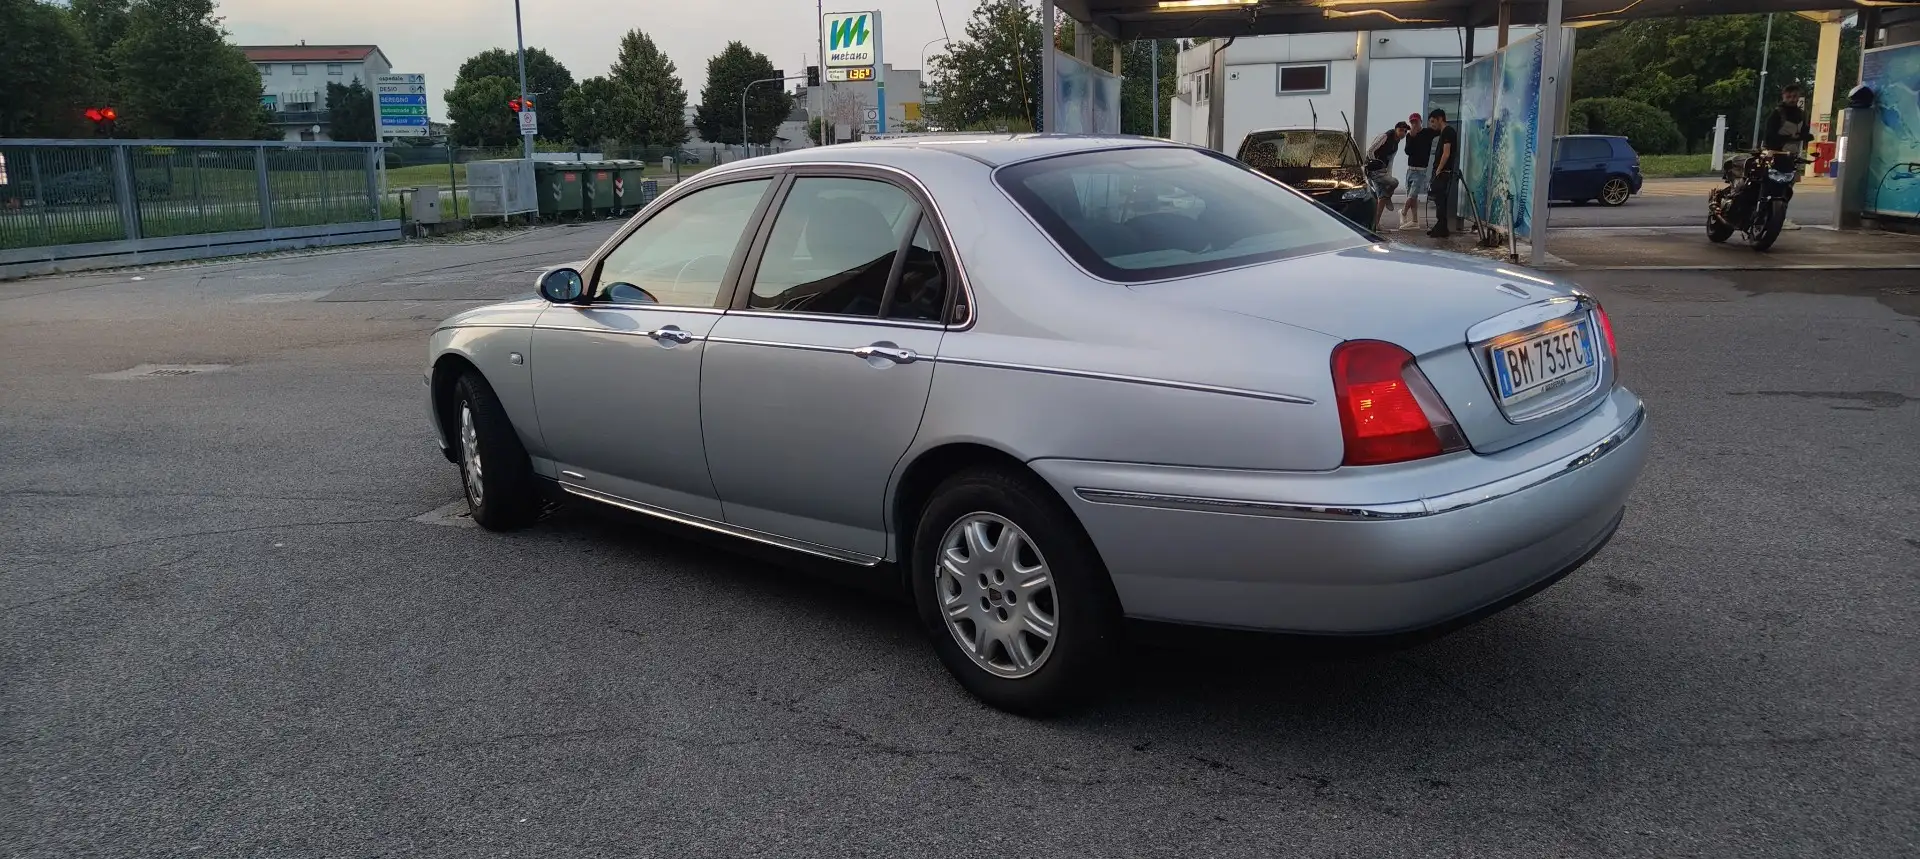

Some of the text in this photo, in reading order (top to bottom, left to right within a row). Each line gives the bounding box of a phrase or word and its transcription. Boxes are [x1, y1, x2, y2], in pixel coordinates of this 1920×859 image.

[831, 51, 868, 61] metano
[1507, 345, 1534, 388] BM
[1533, 330, 1583, 379] 733FC
